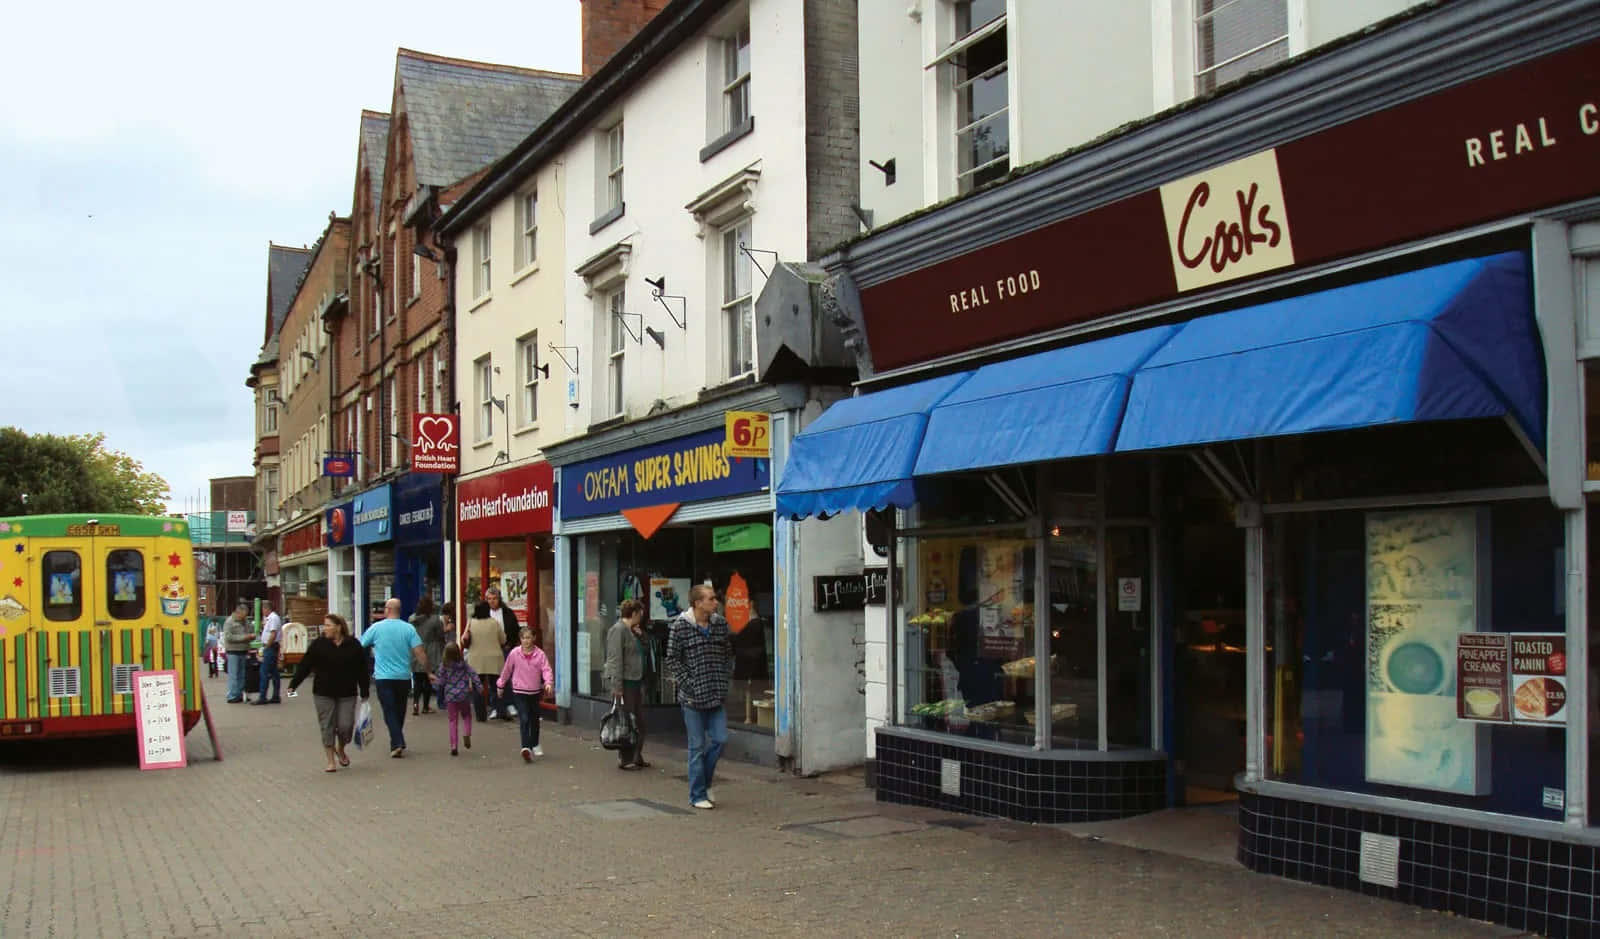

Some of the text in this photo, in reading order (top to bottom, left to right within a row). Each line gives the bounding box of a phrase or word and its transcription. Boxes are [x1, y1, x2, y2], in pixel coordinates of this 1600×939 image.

[1465, 116, 1556, 168] REAL
[1177, 181, 1281, 273] Cooks
[950, 269, 1040, 313] REAL FOOD
[415, 462, 457, 470] Foundation
[584, 439, 731, 501] OXFAM SUPER SAVINGS
[460, 497, 481, 521] British
[482, 496, 501, 518] Heart
[502, 485, 549, 514] Foundation
[1459, 648, 1506, 661] PINEAPPLE
[1514, 641, 1552, 654] TOASTED
[1463, 661, 1501, 673] CREAMS
[1514, 658, 1545, 671] PANINI
